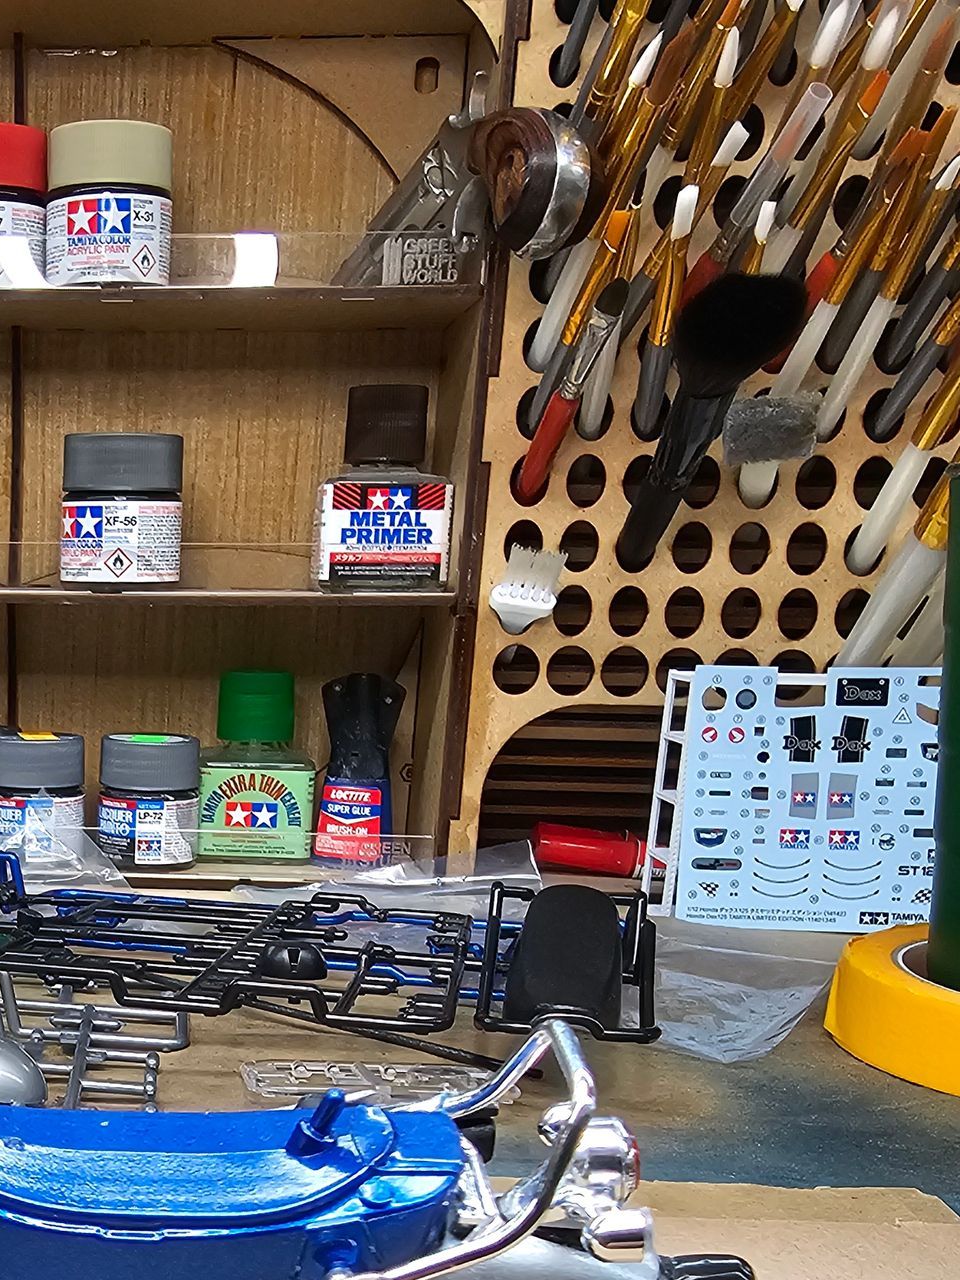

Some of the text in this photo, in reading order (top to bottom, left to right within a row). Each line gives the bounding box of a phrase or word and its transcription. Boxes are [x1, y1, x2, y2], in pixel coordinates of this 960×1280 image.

[133, 209, 155, 223] X-31
[67, 234, 132, 247] TAMIYA COLOR
[66, 244, 131, 256] ACRYLIC PAINT
[104, 516, 138, 527] XF-56
[350, 511, 427, 528] METAL
[340, 528, 433, 545] PRIMER
[843, 685, 882, 701] Dax
[782, 735, 822, 751] Dax
[831, 735, 872, 752] Dax
[200, 790, 226, 824] TAMIYA
[217, 772, 257, 801] EXTRA
[258, 773, 288, 801] THIN
[330, 789, 372, 802] LOCTITE
[138, 811, 164, 820] LP-72
[326, 803, 372, 817] SUPER GLUE
[326, 823, 369, 836] BRUSH-ON
[779, 842, 810, 850] TAMIYA
